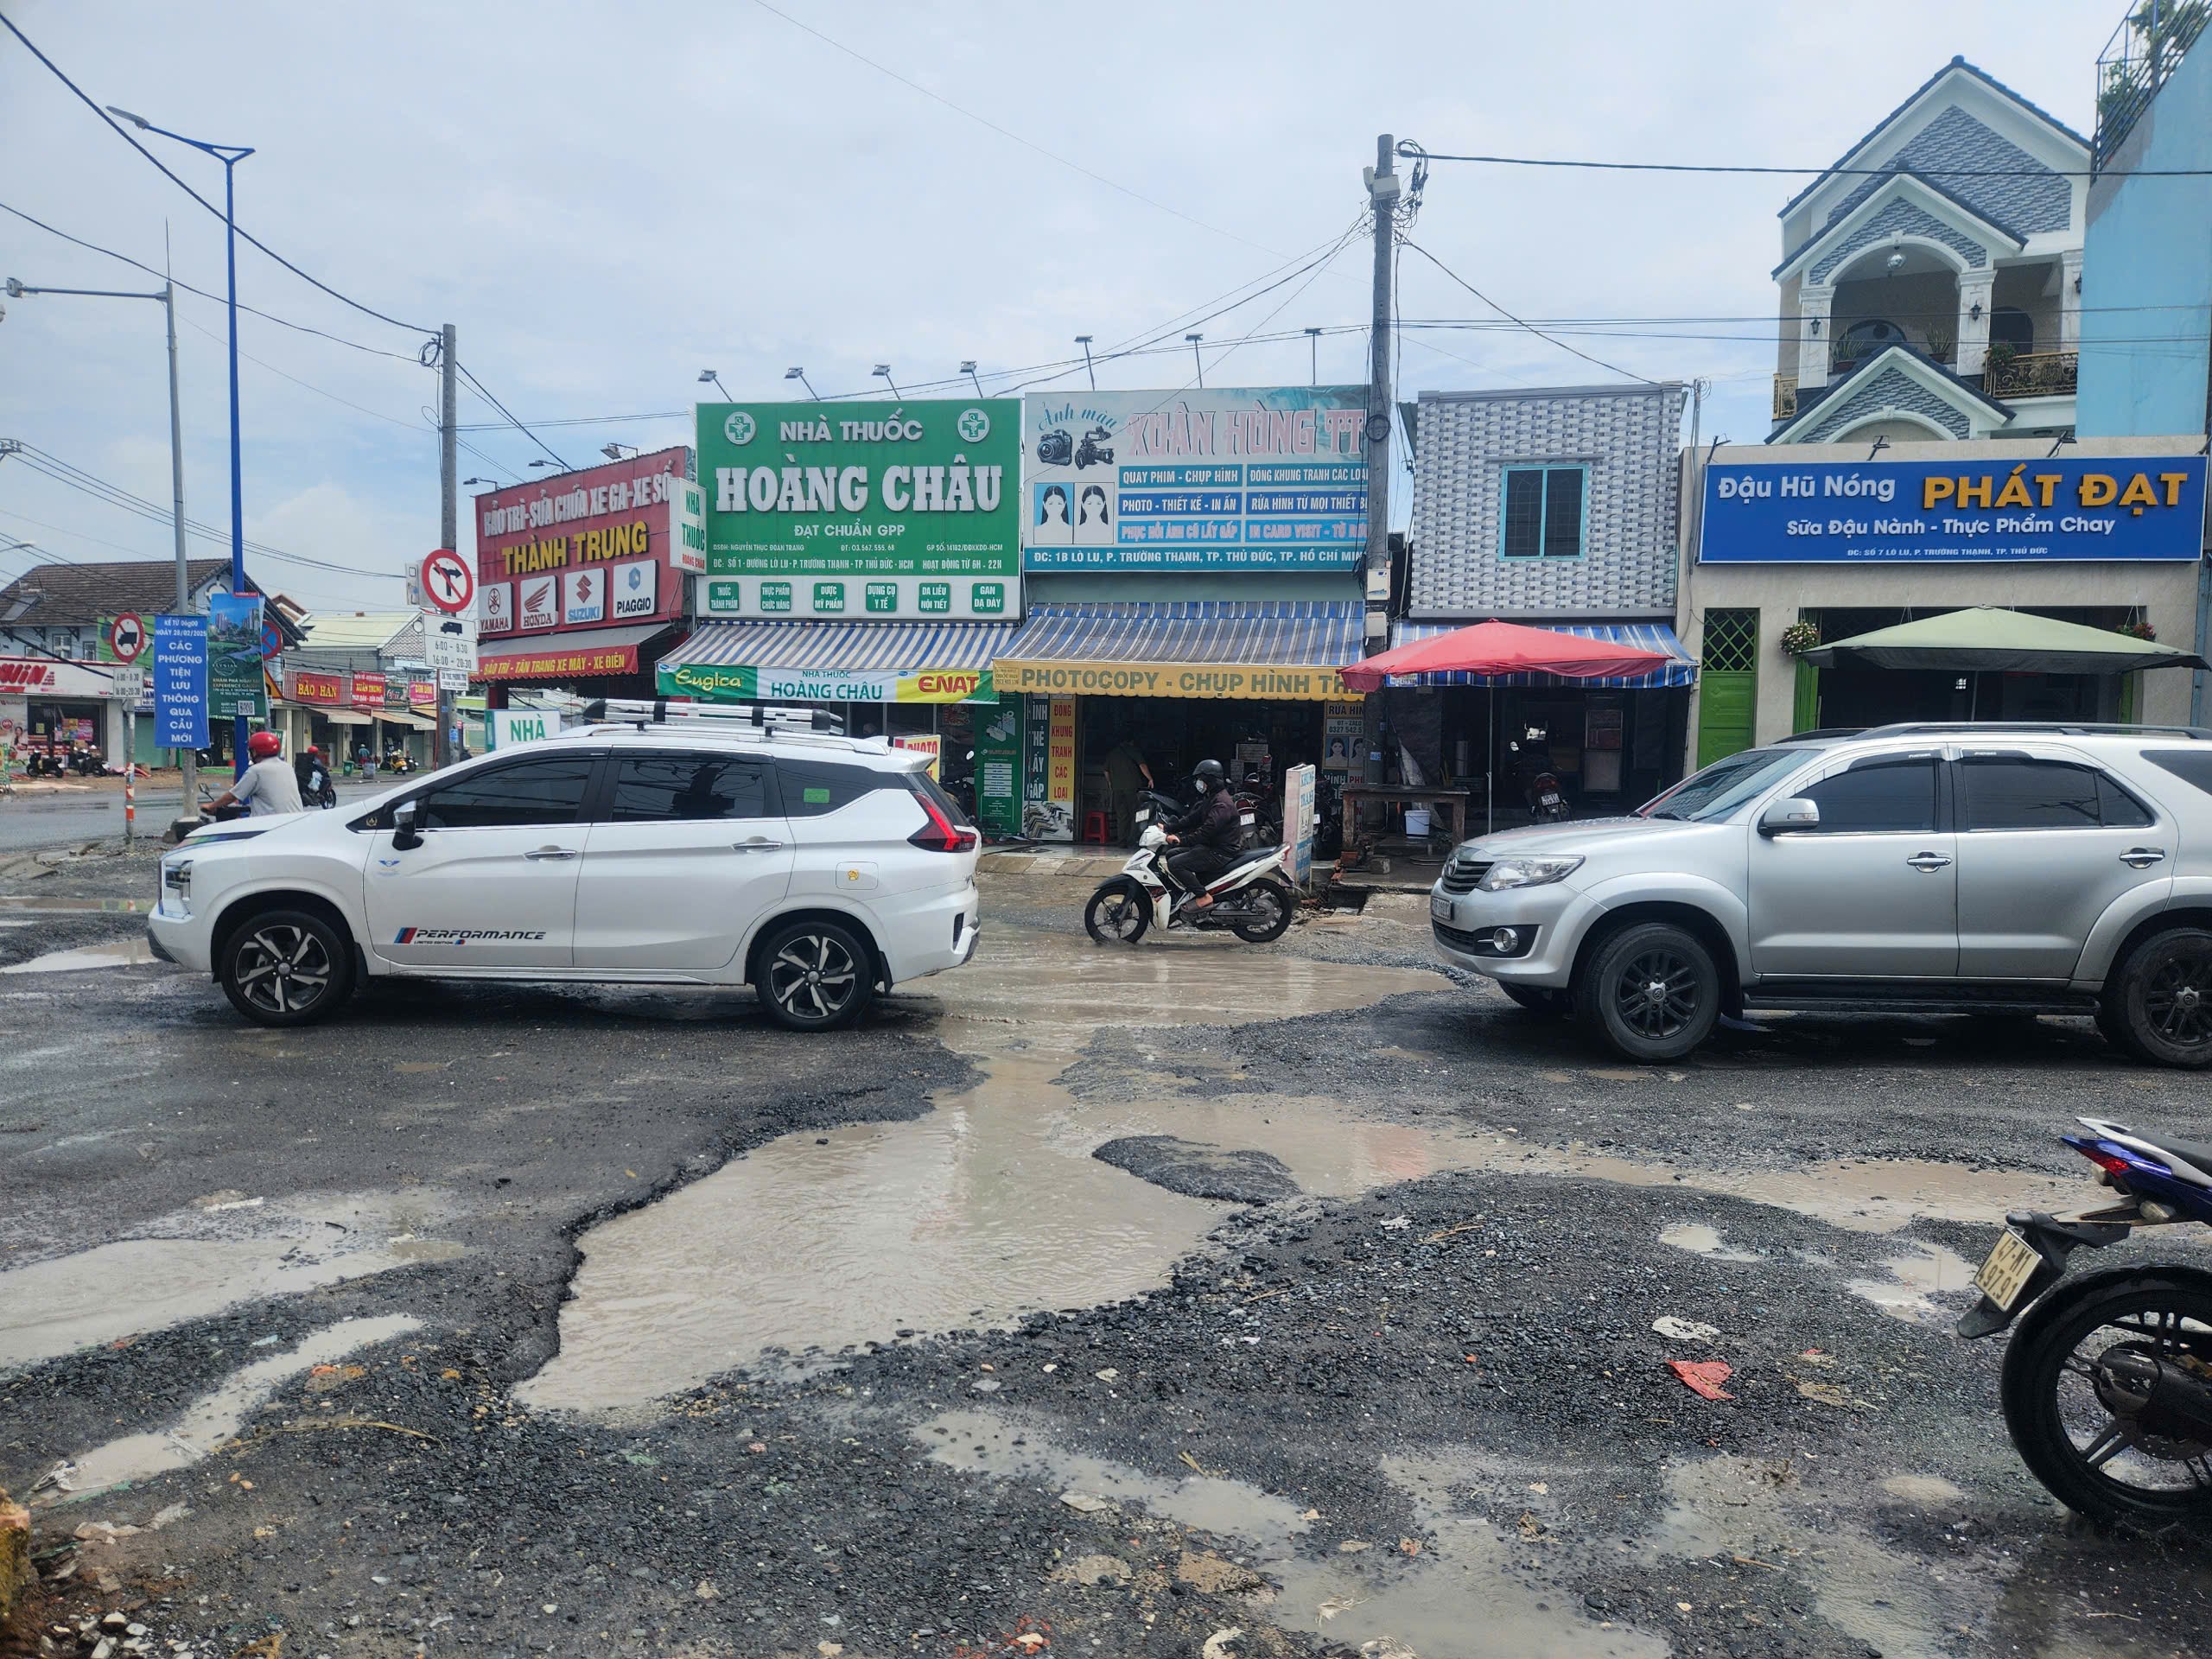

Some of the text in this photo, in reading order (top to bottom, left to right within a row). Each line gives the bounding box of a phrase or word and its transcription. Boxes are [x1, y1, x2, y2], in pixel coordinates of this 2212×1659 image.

[780, 408, 924, 442] NHÀ THUỐC
[1127, 402, 1216, 456] XUÂN
[1225, 399, 1317, 454] HÙNG
[1123, 467, 1237, 485] QUAY PHIM CHỤP HÌNH
[1250, 467, 1272, 481] ĐÓNG
[1274, 469, 1301, 481] KHUNG
[1304, 468, 1329, 480] TRANH
[1332, 467, 1348, 480] CÁC
[715, 454, 1002, 512] HOÀNG CHÂU
[1718, 462, 2188, 516] Đậu Hũ Nóng PHÁT ĐẠT
[590, 486, 608, 516] XE
[685, 490, 701, 516] NHÀ
[1122, 494, 1236, 512] PHOTO THIẾT KẾ IN ẤN
[1251, 492, 1357, 512] RỬA HÌNH TỪ MỌI THIẾT
[794, 518, 906, 538] ĐẠT CHUẨN GPP
[1787, 513, 2115, 538] Sữa Đậu Nành Thực Phẩm Chay
[682, 521, 705, 551] THUỐC
[501, 520, 647, 575] THÀNH TRUNG
[1034, 548, 1338, 563] ĐC: 1B LÒ LU, P. TRƯỜNG THẠNH, TP. THỦ ĐỨC, TP. HỒ CHÍ
[899, 559, 913, 569] HCM
[980, 586, 995, 595] GAN
[616, 597, 652, 614] PIAGGIO
[524, 612, 553, 627] HONDA
[568, 606, 600, 622] SUZUKI
[480, 617, 509, 632] YAMAHA
[168, 640, 193, 651] CÁC
[158, 654, 202, 664] PHƯƠNG
[531, 659, 556, 672] TRANG
[556, 658, 568, 671] XE
[593, 656, 603, 670] XE
[169, 668, 191, 678] TIỆN
[675, 670, 741, 691] Eugica
[802, 670, 851, 678] NHÀ THUỐC
[171, 681, 190, 690] LƯU
[771, 679, 883, 700] HOÀNG CHÂU
[918, 676, 979, 693] ENAT
[1021, 669, 1160, 690] PHOTOCOPY
[1179, 672, 1244, 697] CHỤP
[1251, 669, 1309, 693] HÌNH
[162, 693, 200, 702] THÔNG
[169, 708, 193, 716] QUA
[1053, 702, 1071, 716] ĐÓNG
[169, 718, 193, 729] CẦU
[510, 714, 545, 741] NHÀ
[171, 733, 192, 742] MỚI
[1052, 725, 1073, 738] KHUNG
[1052, 746, 1072, 758] TRANH
[1054, 763, 1068, 778] CÁC
[1053, 786, 1068, 801] LOẠI
[416, 929, 547, 940] PERFORMANCE
